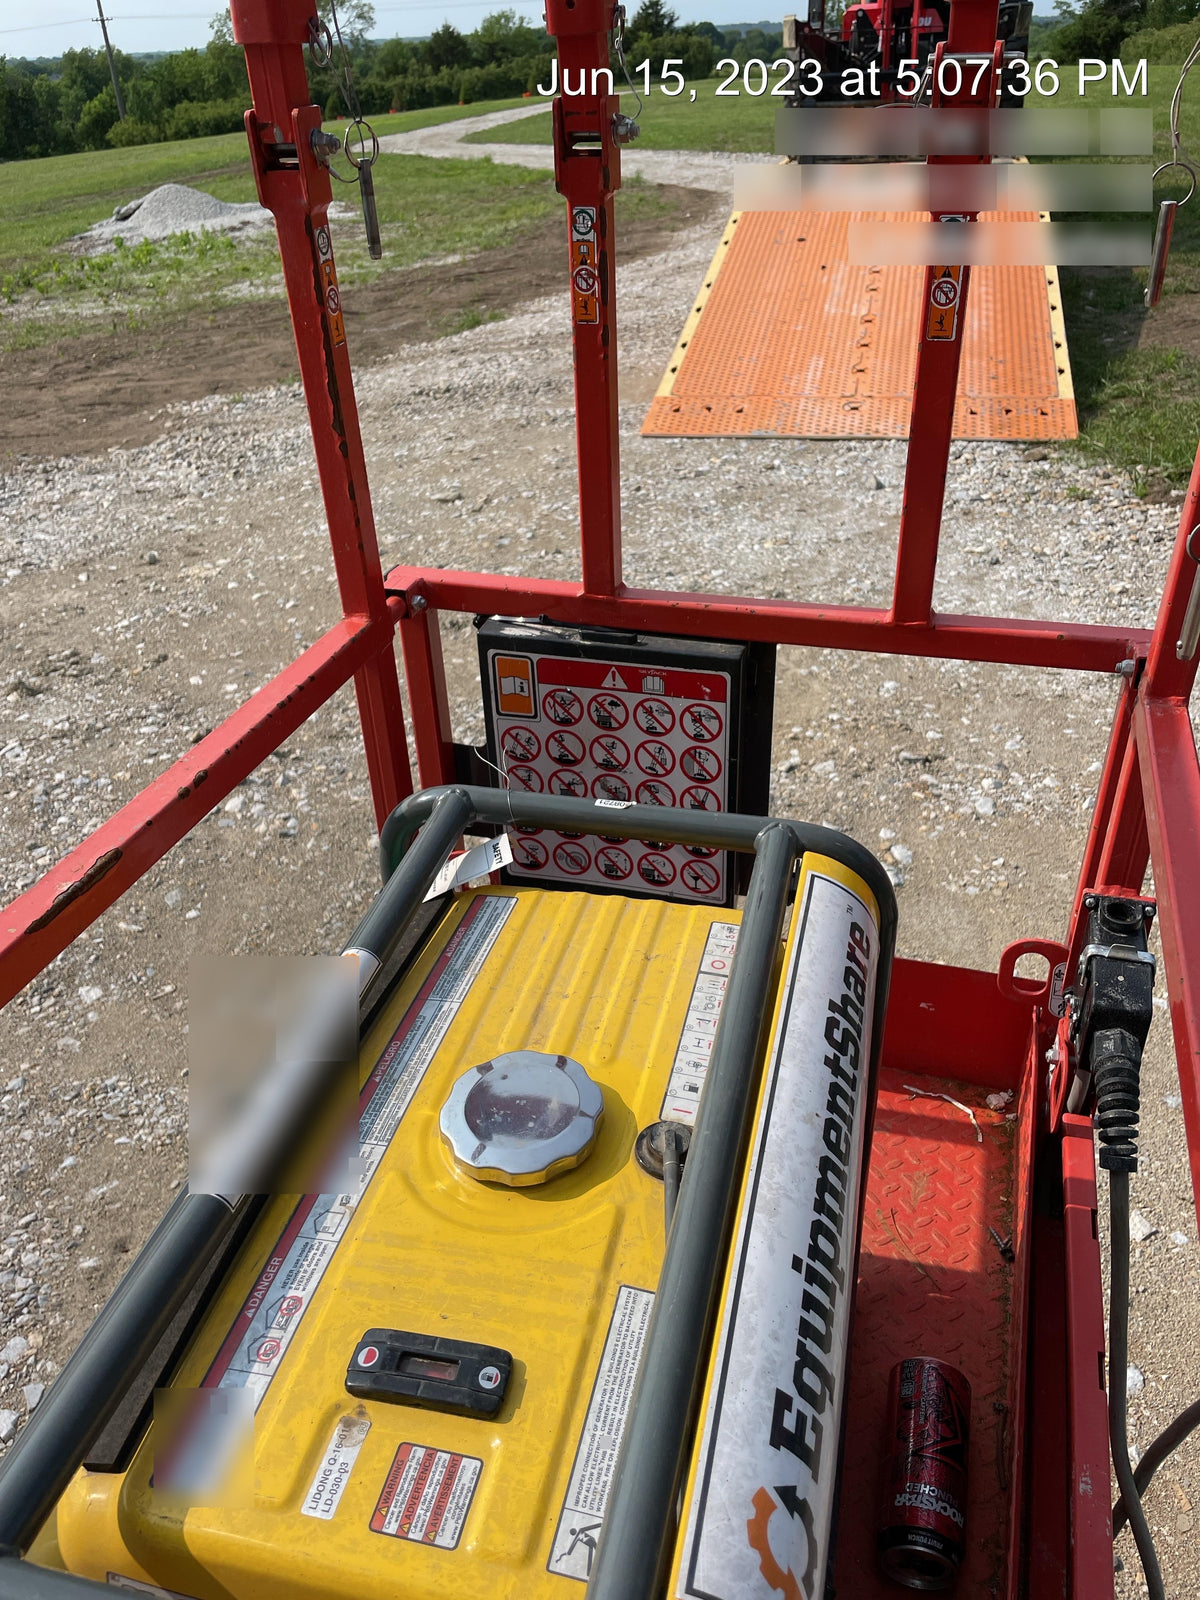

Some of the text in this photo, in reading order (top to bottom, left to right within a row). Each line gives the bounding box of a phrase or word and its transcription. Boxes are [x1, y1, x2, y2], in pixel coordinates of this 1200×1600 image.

[492, 842, 504, 865] SAFETY
[449, 927, 468, 953] DANGER
[376, 1041, 401, 1078] PELIGRO
[769, 920, 871, 1483] EquipmentShare
[249, 1257, 282, 1307] DANGER
[280, 1241, 309, 1288] NEVER use inside
[293, 1274, 306, 1290] EVEN
[305, 1251, 317, 1267] doors
[314, 1241, 323, 1251] and
[299, 1267, 316, 1291] windows
[313, 1257, 321, 1266] are
[623, 1290, 632, 1310] SYSTEM
[615, 1311, 626, 1342] ELECTRICAL
[607, 1343, 619, 1373] BUILDING'S
[584, 1471, 594, 1493] ALLOW
[599, 1403, 611, 1431] CURRENT
[606, 1386, 615, 1403] FROM
[614, 1341, 626, 1373] GENERATOR
[624, 1305, 635, 1332] BACKFEED
[595, 1387, 607, 1422] GENERATOR
[603, 1463, 611, 1477] FIRE
[618, 1375, 632, 1415] CONNECTIONS
[638, 1299, 650, 1330] ELECTRICAL
[588, 1486, 598, 1510] UTILITY
[599, 1449, 607, 1464] THIS
[606, 1413, 616, 1435] RESULT
[613, 1358, 629, 1404] ELECTROCUTION
[627, 1329, 636, 1349] UTILITY
[592, 1423, 599, 1431] OF
[582, 1432, 596, 1472] CONNECTION
[308, 1467, 332, 1510] LIDONG
[321, 1461, 349, 1513] LD-030-03
[382, 1458, 403, 1505] WARNING
[384, 1448, 418, 1529] Cancer and Reproductive Harm
[405, 1450, 434, 1520] ADVERTENCIA
[420, 1490, 429, 1506] daño
[426, 1455, 443, 1490] reproductivo
[429, 1457, 460, 1527] AVERTISSEMENT
[437, 1515, 449, 1537] Cancer
[448, 1464, 466, 1504] malformations
[574, 1473, 586, 1506] IMPROPER
[894, 1493, 964, 1528] ROCKSTAR
[907, 1533, 927, 1544] PUNCH
[927, 1537, 943, 1549] FRUIT
